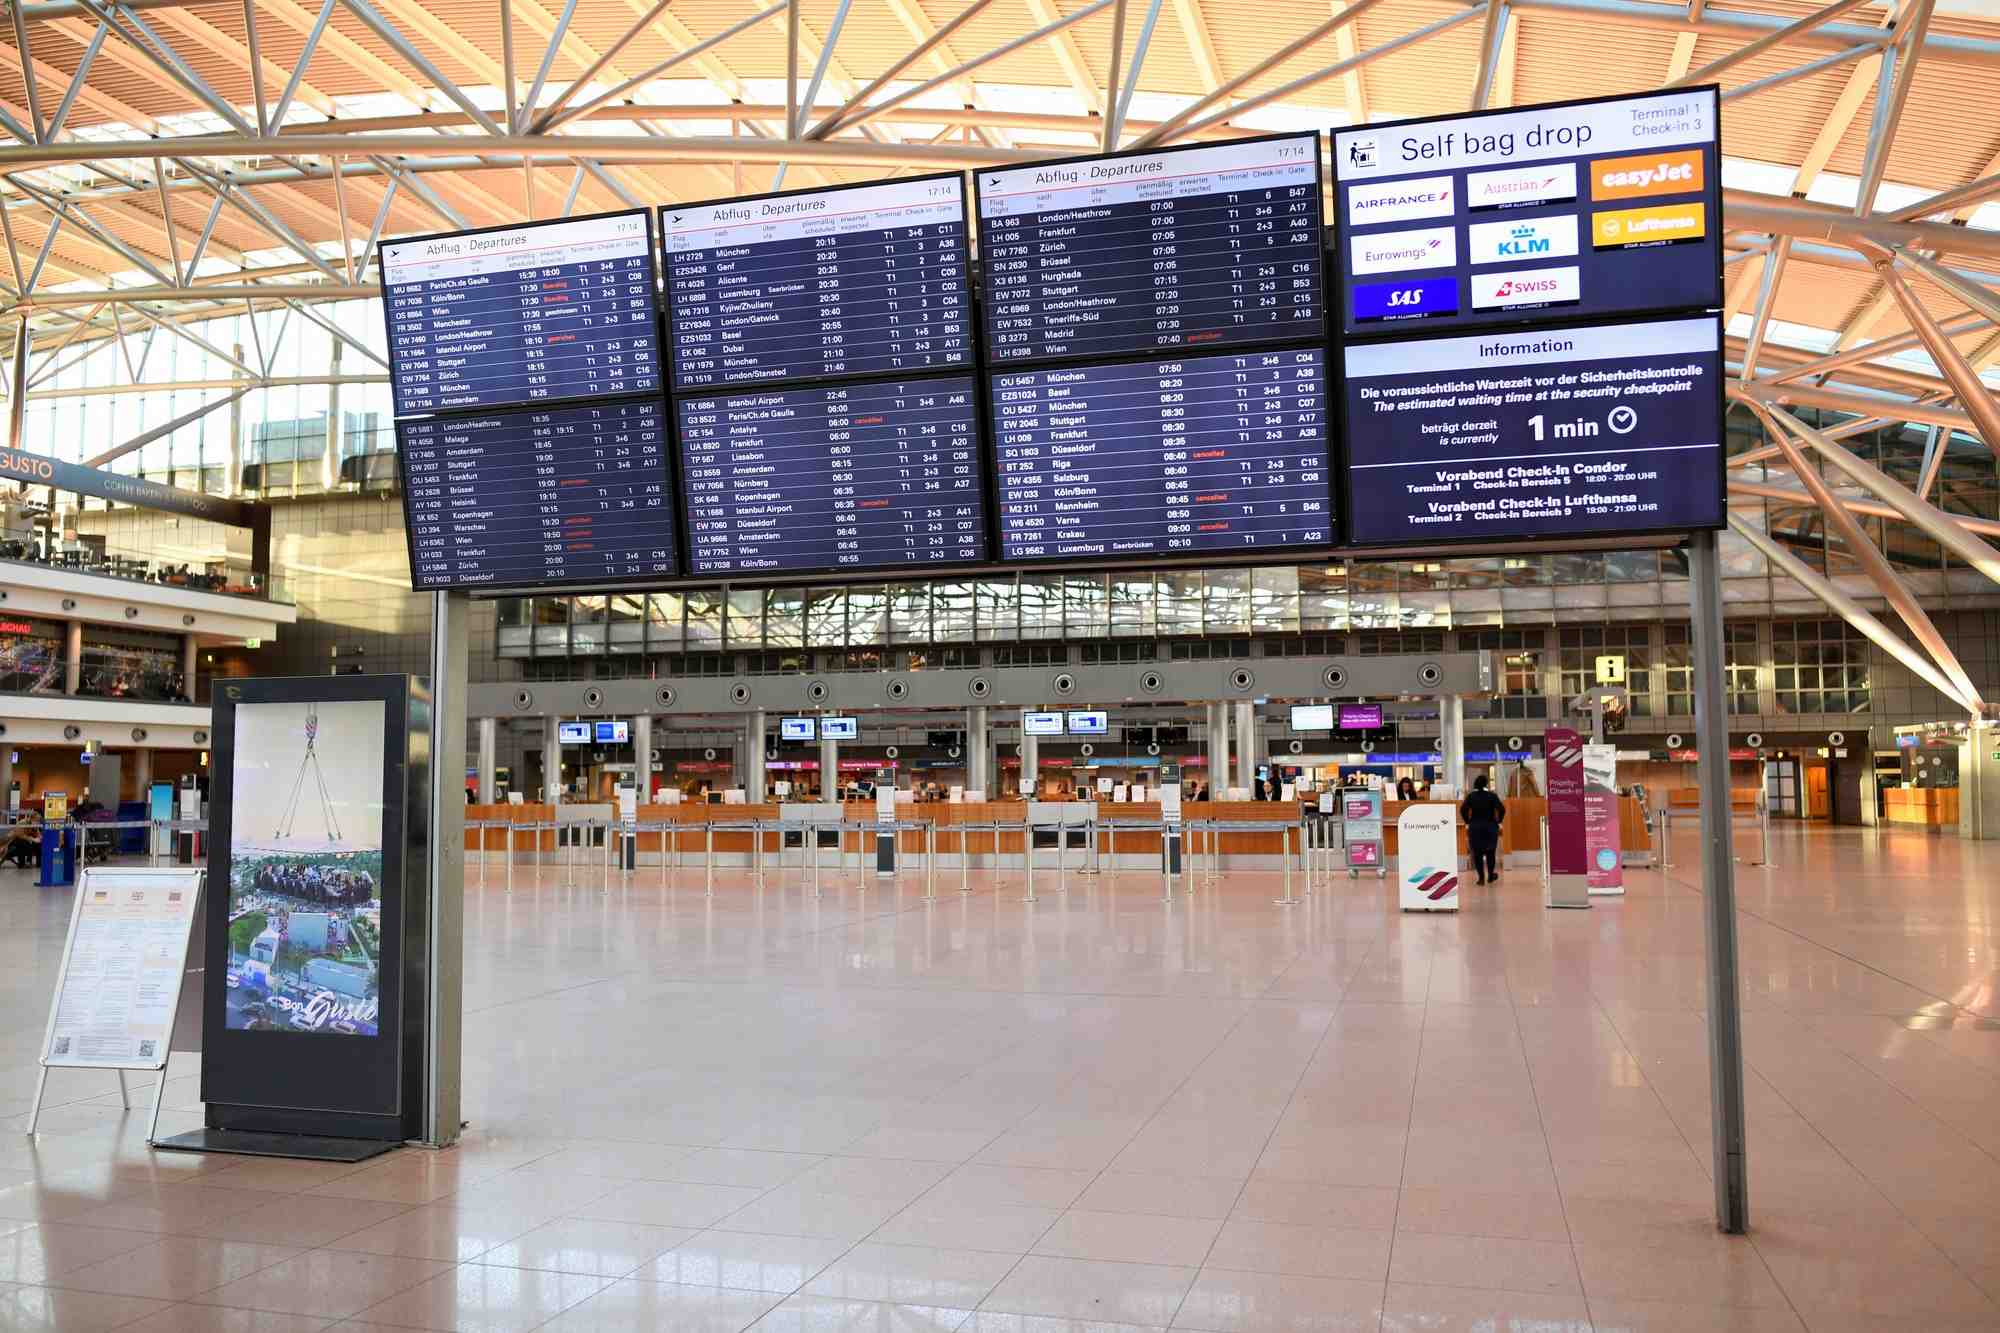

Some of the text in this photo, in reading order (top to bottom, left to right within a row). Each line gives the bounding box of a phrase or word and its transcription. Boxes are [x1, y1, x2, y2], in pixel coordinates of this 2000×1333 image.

[1629, 103, 1688, 120] Terminal
[1632, 120, 1689, 136] Check-in
[1401, 123, 1591, 161] Self bag drop
[1035, 170, 1077, 184] Abflug
[1090, 161, 1163, 178] Departures
[1601, 162, 1692, 187] easyJet
[1483, 181, 1538, 194] Austrian
[1355, 193, 1434, 208] AIRFRANCE
[713, 208, 750, 221] Abflug
[761, 200, 825, 216] Departures
[1037, 200, 1173, 223] London/Heathrow 07:00
[1038, 215, 1174, 237] Frankfurt 07:00
[1627, 217, 1695, 232] Lufthansa
[426, 235, 527, 255] Abflug Departures
[1039, 230, 1175, 252] Zürich 07:05
[1498, 238, 1549, 255] KLM
[715, 248, 750, 257] München
[1365, 248, 1426, 261] Eurowings
[716, 262, 735, 271] Genf
[1040, 255, 1071, 267] Brüssel
[717, 276, 747, 285] Alicante
[1041, 269, 1081, 281] Hurghada
[1042, 275, 1177, 295] Stuttgart 07:15
[1514, 279, 1556, 292] SWISS
[430, 293, 465, 302] Köln/Bonn
[718, 288, 760, 299] Luxemburg
[1386, 288, 1423, 306] SAS
[1042, 290, 1178, 310] London/Heathrow 07:20
[431, 307, 449, 315] Wien
[1043, 305, 1179, 324] Teneriffa-Süd 07:20
[433, 319, 471, 328] Manchester
[720, 313, 779, 326] London/Gatwick
[721, 330, 741, 339] Basel
[1044, 319, 1179, 338] Madrid 07:30
[435, 343, 486, 354] Istanbul Airport
[722, 343, 744, 353] Dubai
[1045, 344, 1067, 353] Wien
[1157, 334, 1180, 344] 07:40
[1479, 338, 1573, 357] Information
[436, 358, 466, 366] Stuttgart
[723, 348, 843, 366] München 21:10
[438, 370, 459, 380] Zürich
[724, 367, 786, 380] London/Stansted
[1047, 363, 1182, 382] München 07:50
[1360, 364, 1703, 398] Die voraussichtliche Wartezeit vor der Sicherheitskontrolle
[439, 383, 470, 392] München
[1047, 387, 1070, 397] Basel
[440, 396, 479, 405] Amsterdam
[727, 390, 847, 407] Istanbul Airport 22:45
[1373, 380, 1692, 412] The estimated waiting time at the security checkpoint
[1048, 401, 1087, 411] München
[770, 408, 794, 417] Gaulle
[1049, 415, 1086, 426] Stuttgart
[1421, 419, 1497, 434] beträgt derzeit
[729, 425, 757, 434] Antalya
[1528, 414, 1598, 441] 1 min
[1050, 430, 1087, 439] Frankfurt
[1439, 432, 1499, 445] is currently
[730, 438, 763, 447] Frankfurt
[1051, 442, 1095, 454] Düsseldorf
[731, 452, 764, 461] Lissabon
[732, 465, 775, 474] Amsterdam
[1052, 459, 1071, 469] Riga
[1053, 473, 1089, 482] Salzburg
[1435, 461, 1627, 482] Vorabend Check-In Condor
[733, 479, 768, 487] Nürnberg
[1406, 483, 1451, 493] Terminal
[1473, 479, 1519, 489] Check-In
[1521, 477, 1561, 487] Bereich
[1563, 476, 1571, 484] 5
[1585, 474, 1607, 482] 18:00
[1613, 473, 1636, 481] 20:00
[1637, 471, 1657, 480] UHR
[734, 492, 780, 502] Kopenhagen
[1054, 486, 1096, 496] Köln/Bonn
[735, 504, 792, 514] Istanbul Airport
[1055, 500, 1099, 510] Mannheim
[1428, 493, 1637, 513] Vorabend Check-In Lufthansa
[452, 511, 493, 519] Kopenhagen
[1407, 513, 1452, 523] Terminal
[1474, 510, 1520, 520] Check-In
[1522, 507, 1562, 518] Bereich
[1564, 507, 1572, 515] 9
[1614, 504, 1636, 512] 21:00
[1637, 503, 1657, 511] UHR
[737, 518, 776, 528] Düsseldorf
[1055, 516, 1080, 524] Varna
[455, 536, 472, 544] Wien
[738, 532, 780, 541] Amsterdam
[1056, 530, 1085, 538] Krakau
[738, 546, 758, 554] Wien
[1057, 543, 1104, 553] Luxemburg
[1168, 538, 1191, 547] 09:10
[740, 559, 778, 567] Köln/Bonn
[459, 572, 494, 581] Düsseldorf
